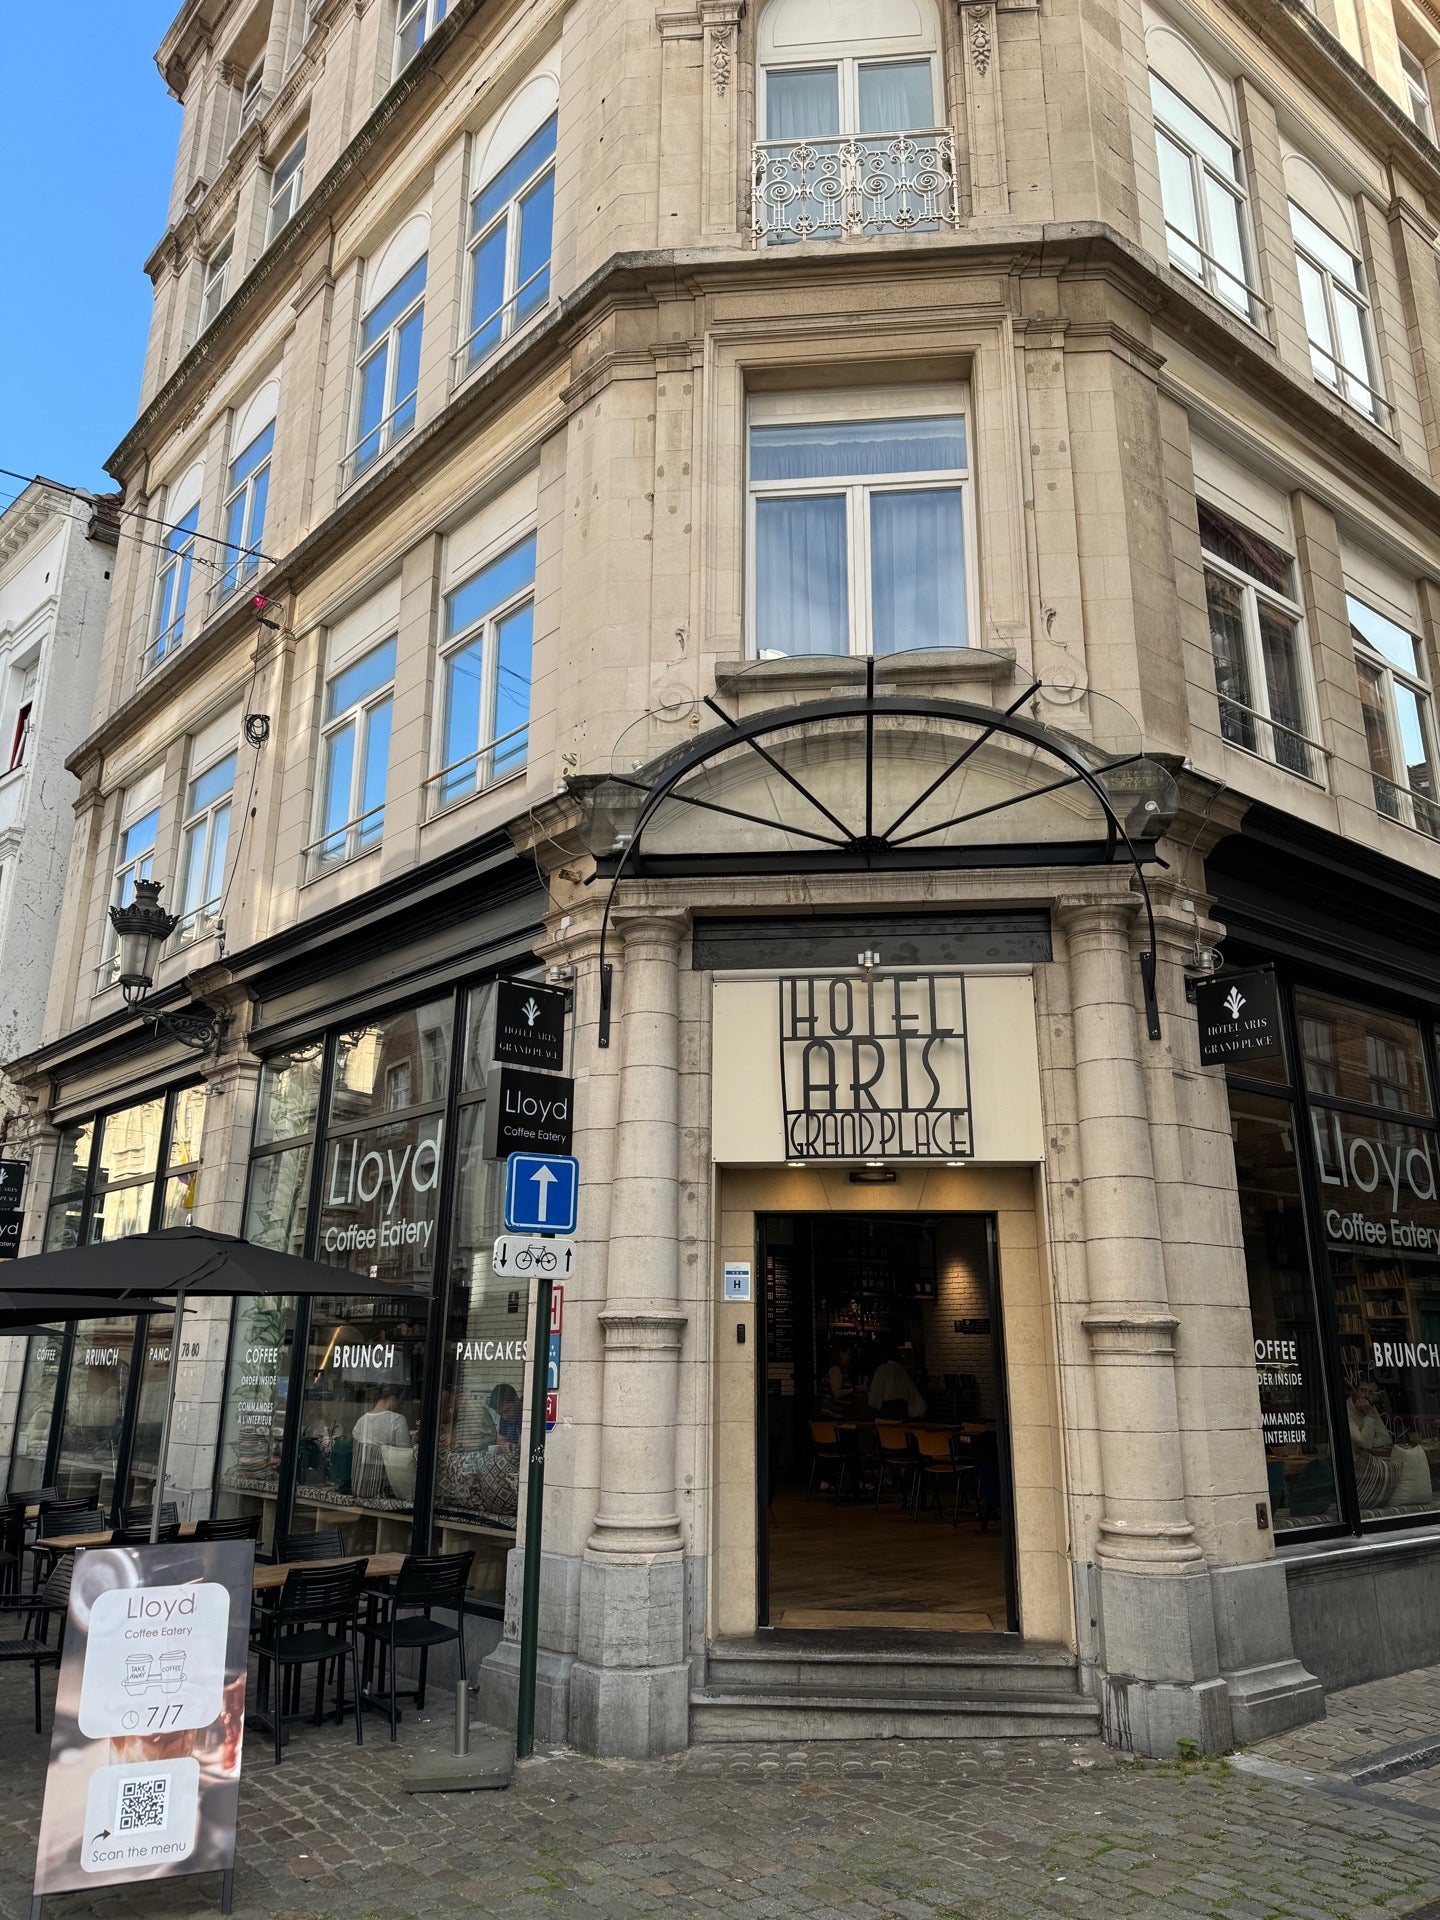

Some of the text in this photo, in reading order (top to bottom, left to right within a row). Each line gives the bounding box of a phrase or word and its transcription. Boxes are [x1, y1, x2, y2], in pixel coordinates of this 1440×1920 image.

[790, 975, 955, 1038] HOTEL
[1244, 1018, 1267, 1030] ARIS
[802, 1039, 940, 1110] ARIS
[505, 1089, 568, 1123] Lloyd
[503, 1126, 567, 1144] Coffee Eatery
[328, 1118, 443, 1215] Lloyd
[1310, 1111, 1438, 1213] Lloyd
[325, 1218, 434, 1252] Coffee Eatery
[1326, 1209, 1440, 1256] Coffee Eatery
[0, 1241, 16, 1249] atery
[733, 1279, 741, 1289] H
[36, 1349, 56, 1361] COFFEE
[84, 1348, 119, 1366] BRUNCH
[245, 1347, 278, 1364] COFFEE
[333, 1344, 395, 1369] BRUNCH
[456, 1340, 527, 1361] PANCAKES
[1254, 1339, 1297, 1360] OFFEE
[1373, 1341, 1440, 1368] BRUNCH
[241, 1375, 277, 1386] ORDER INSIDE
[1257, 1373, 1303, 1386] DER INSIDE
[238, 1401, 273, 1412] COMMANDES
[1261, 1412, 1306, 1426] MMANDES
[1264, 1430, 1307, 1444] INTERIEUR
[127, 1593, 196, 1622] Lloyd
[124, 1626, 193, 1640] Coffee Eatery
[162, 1665, 182, 1673] COFFEE
[146, 1704, 184, 1729] 7/7
[91, 1842, 186, 1863] Scan the menu
